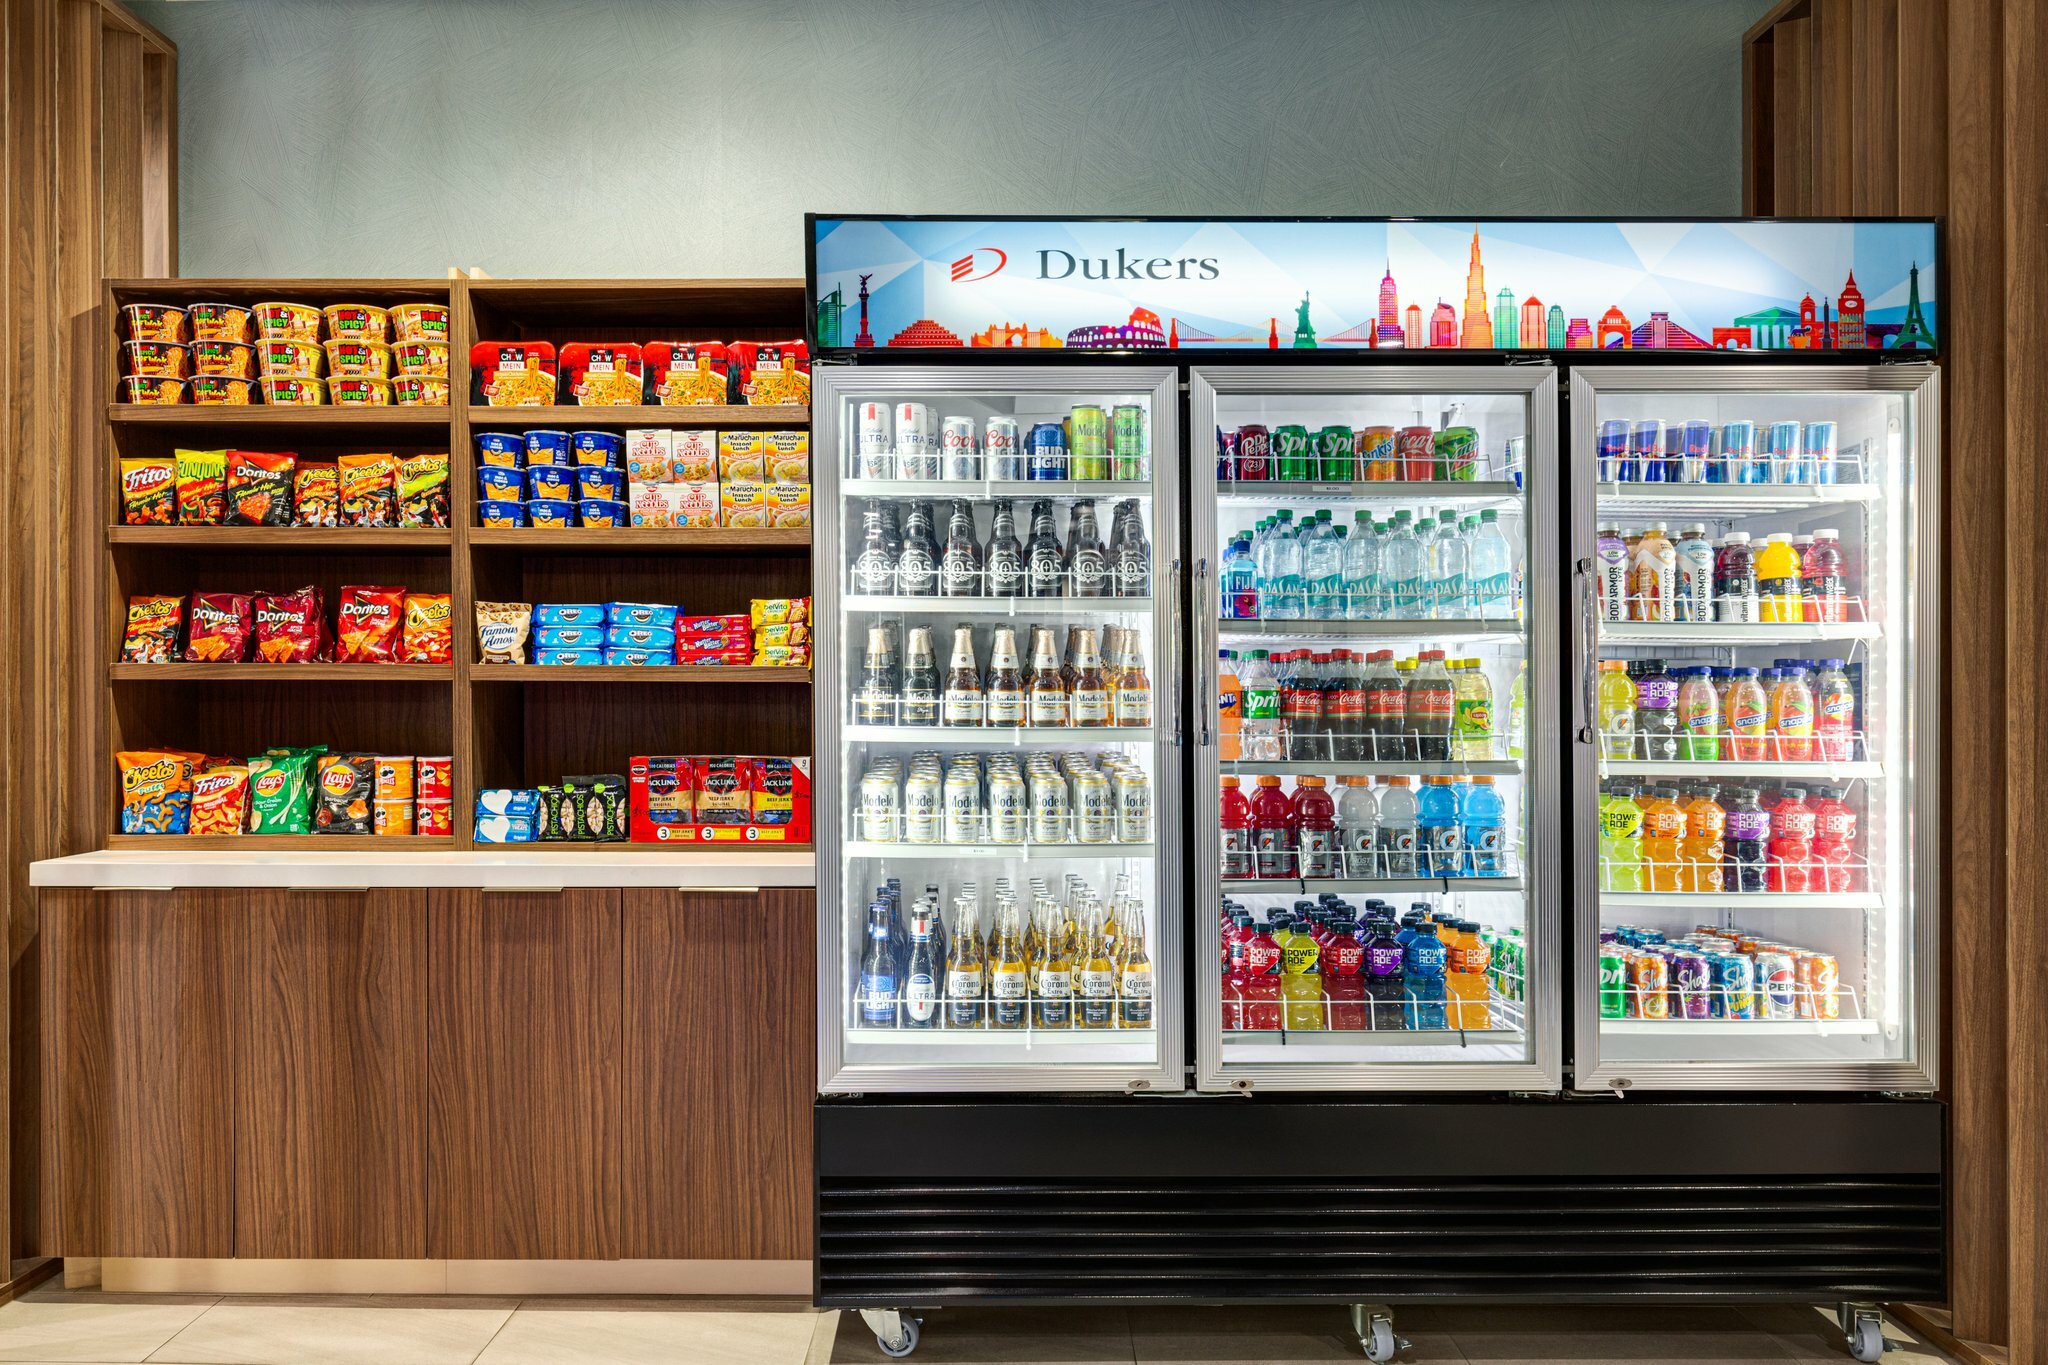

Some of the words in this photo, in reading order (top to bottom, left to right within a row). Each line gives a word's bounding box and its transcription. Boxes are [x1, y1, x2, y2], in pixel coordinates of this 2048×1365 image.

[1036, 247, 1221, 281] Dukers
[264, 318, 288, 330] SPICY
[339, 319, 365, 331] SPICY
[422, 320, 447, 331] SPICY
[269, 354, 294, 364] SPICY
[340, 353, 366, 365] SPICY
[402, 354, 425, 366] SPICY
[273, 390, 298, 401] SPICY
[342, 390, 367, 401] SPICY
[399, 389, 420, 401] SPICY
[728, 434, 760, 443] Maruchan
[773, 434, 805, 443] Maruchan
[1256, 433, 1267, 446] Dr
[641, 440, 659, 449] CUP
[685, 441, 704, 450] CUP
[1035, 446, 1063, 456] BUD
[1031, 457, 1066, 469] LIGHT
[1249, 460, 1258, 468] 23
[236, 465, 282, 480] Doritos
[300, 465, 340, 488] Cheeto
[344, 464, 389, 486] Cheetos
[402, 459, 442, 483] Cheetos
[124, 467, 172, 492] Fritos
[730, 486, 762, 495] Maruchan
[775, 486, 807, 495] Maruchan
[643, 493, 662, 501] CUP
[688, 493, 706, 501] CUP
[859, 561, 891, 577] 805
[900, 561, 932, 577] 805
[943, 562, 974, 577] 805
[989, 562, 1020, 577] 805
[1030, 560, 1062, 577] 805
[1073, 561, 1105, 577] 805
[1116, 561, 1147, 577] 805
[1609, 566, 1619, 622] BODYARMOR
[1697, 567, 1707, 623] BODYARMOR
[128, 600, 173, 622] Cheetos
[342, 602, 390, 616] Doritos
[559, 608, 582, 616] OREO
[630, 609, 654, 617] OREO
[193, 608, 240, 624] Doritos
[257, 610, 305, 623] Doritos
[480, 624, 518, 639] Famous
[559, 630, 582, 638] OREO
[629, 630, 652, 638] OREO
[764, 625, 789, 633] belVita
[483, 635, 513, 650] Amos
[626, 653, 649, 661] OREO
[765, 648, 789, 656] belVita
[1650, 690, 1669, 698] ADE
[801, 759, 807, 768] 9
[124, 760, 177, 792] Cheetos
[193, 775, 236, 796] Fritos
[705, 779, 721, 787] JACK
[763, 779, 778, 788] JACK
[863, 794, 894, 807] Modelo
[908, 793, 938, 807] Modelo
[993, 793, 1024, 808] Modelo
[551, 794, 559, 835] PISTACHIOS
[577, 794, 586, 835] PISTACHIOS
[606, 794, 615, 836] PISTACHIOS
[1609, 820, 1629, 829] ADE
[1658, 820, 1678, 829] ADE
[1739, 820, 1759, 829] ADE
[660, 829, 668, 838] 3
[705, 829, 712, 838] 3
[749, 829, 757, 838] 3
[1309, 834, 1325, 857] G
[1355, 833, 1374, 853] G
[1395, 834, 1412, 852] G
[1250, 948, 1280, 958] POWER
[1250, 956, 1268, 965] ADE
[1287, 956, 1305, 965] ADE
[1340, 956, 1359, 965] ADE
[1372, 956, 1392, 965] ADE
[1419, 956, 1438, 965] ADE
[994, 979, 1024, 990] Corona
[1041, 979, 1069, 989] Corona
[1082, 979, 1111, 989] Corona
[1769, 982, 1796, 991] PEPS
